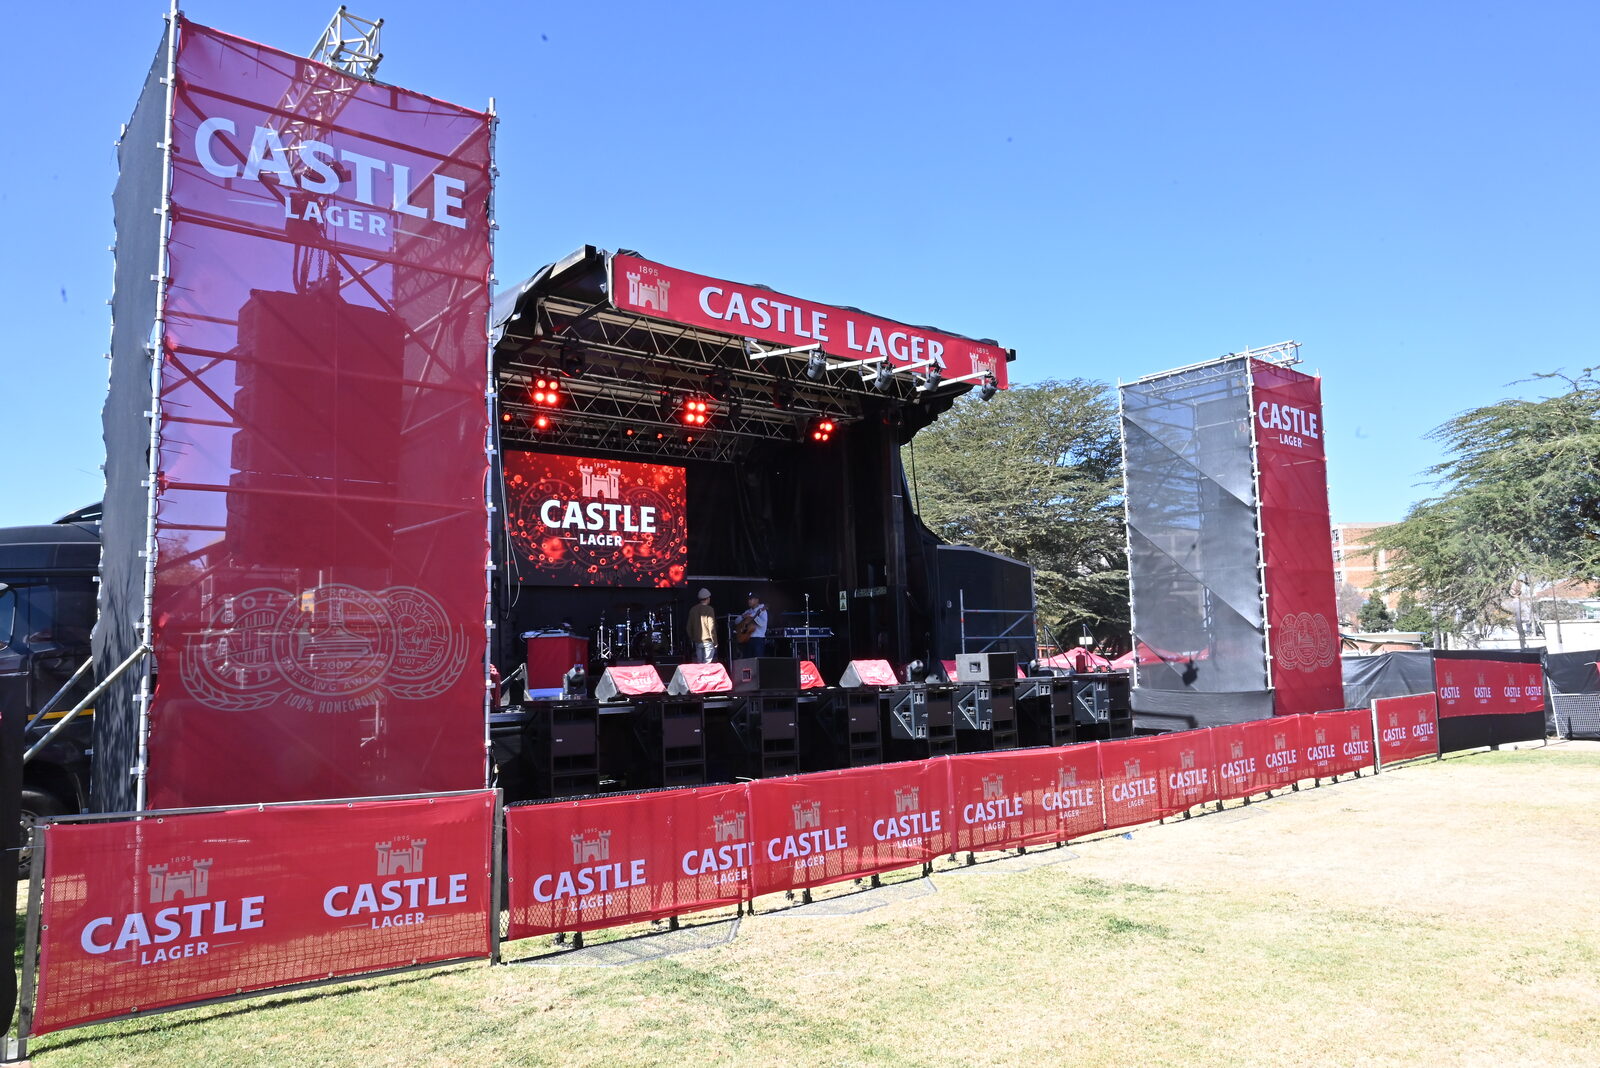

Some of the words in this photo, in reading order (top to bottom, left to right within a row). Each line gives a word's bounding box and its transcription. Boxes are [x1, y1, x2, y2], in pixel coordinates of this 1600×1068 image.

[195, 117, 467, 229] CASTLE
[285, 196, 387, 236] LAGER
[638, 265, 659, 278] 1895
[698, 286, 829, 343] CASTLE
[846, 320, 947, 370] LAGER
[1258, 401, 1319, 440] CASTLE
[1279, 434, 1303, 449] LAGER
[540, 499, 656, 534] CASTLE
[579, 533, 623, 548] LAGER
[1440, 686, 1460, 698] CASTLE
[1474, 687, 1492, 698] CASTLE
[1504, 687, 1521, 698] CASTLE
[1525, 686, 1542, 696] CASTLE
[284, 692, 314, 713] 100%
[318, 688, 385, 714] HOMEGROWN
[1384, 727, 1406, 742] CASTLE
[1412, 722, 1434, 737] CASTLE
[1307, 744, 1336, 760] CASTLE
[1343, 740, 1369, 756] CASTLE
[1266, 750, 1298, 768] CASTLE
[1221, 757, 1256, 780] CASTLE
[1168, 768, 1208, 790] CASTLE
[1112, 777, 1156, 802] CASTLE
[1042, 788, 1094, 811] CASTLE
[963, 796, 1024, 824] CASTLE
[872, 810, 942, 841] CASTLE
[983, 820, 1007, 832] LAGER
[767, 826, 848, 862] CASTLE
[897, 837, 923, 849] LAGER
[170, 855, 192, 864] 1895
[794, 855, 825, 871] LAGER
[532, 858, 647, 903] CASTLE
[712, 871, 748, 886] LAGER
[322, 872, 469, 918] CASTLE
[570, 894, 613, 912] LAGER
[80, 895, 266, 956] CASTLE
[370, 912, 426, 931] LAGER
[140, 941, 210, 966] LAGER
